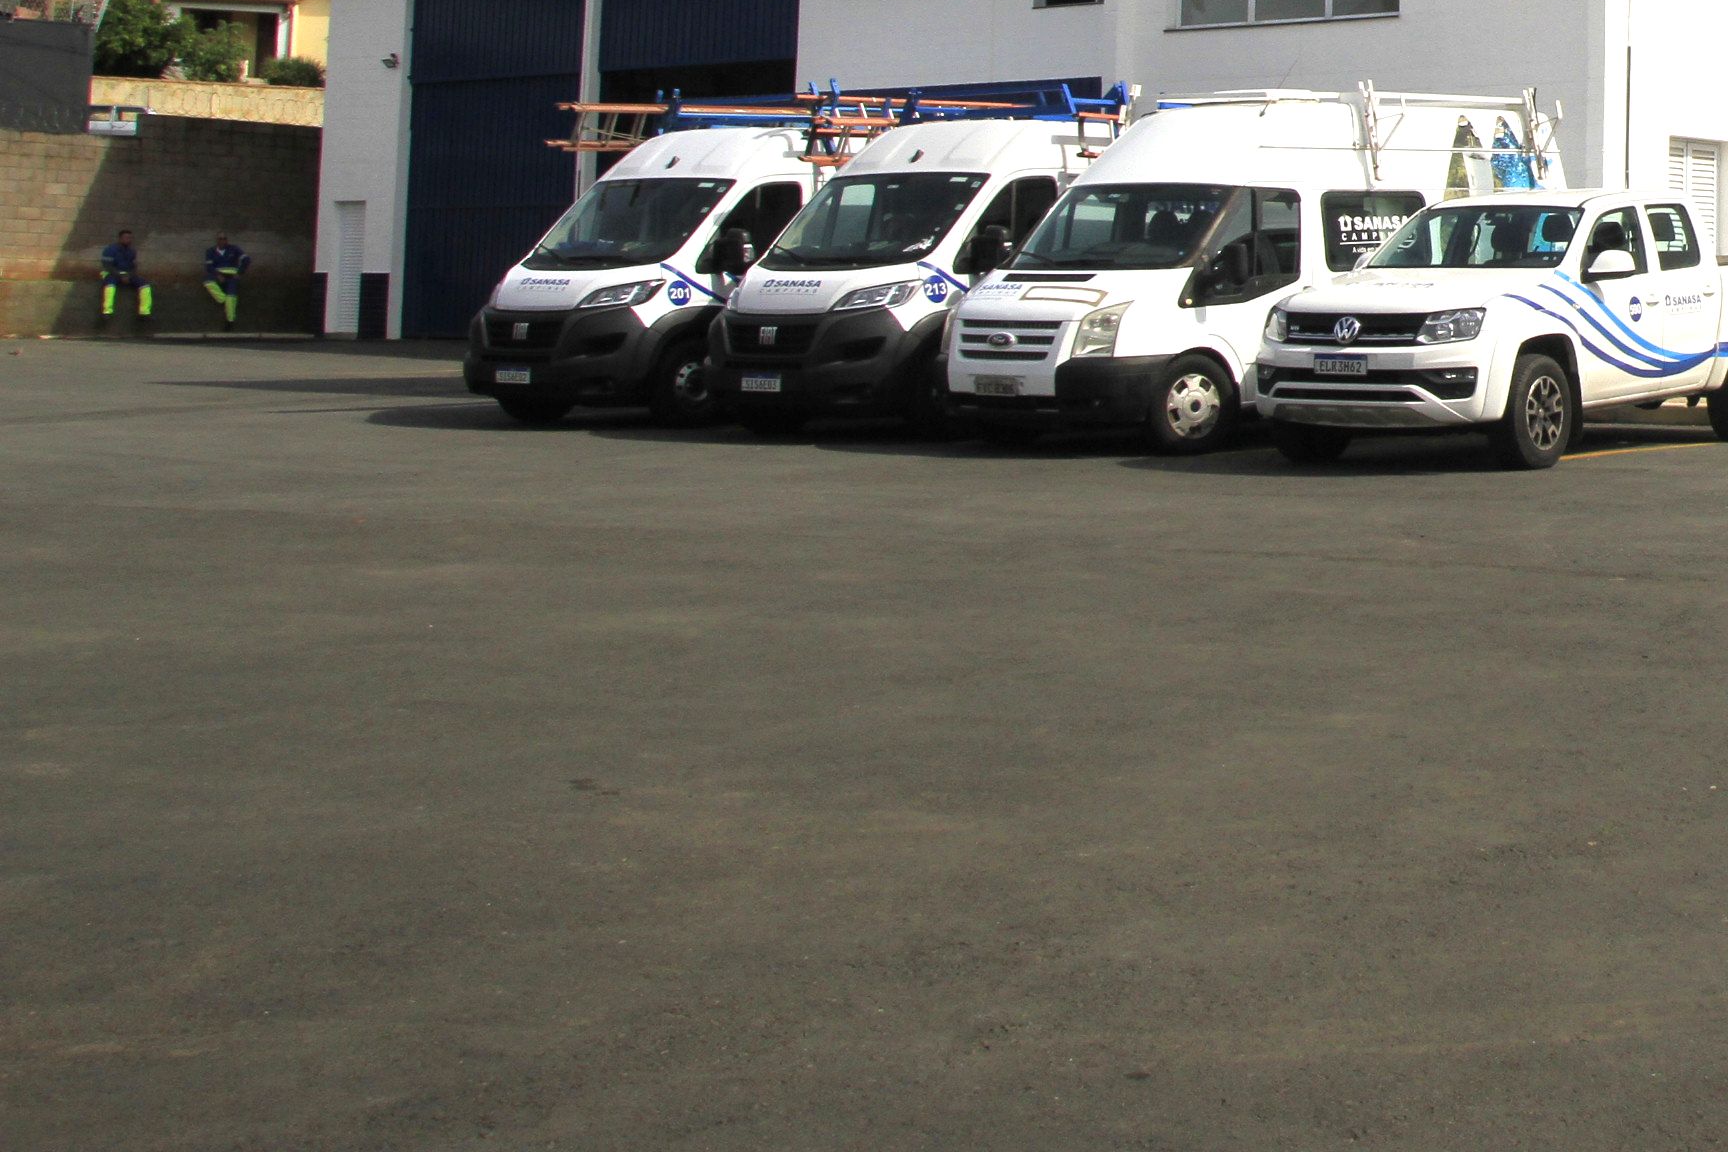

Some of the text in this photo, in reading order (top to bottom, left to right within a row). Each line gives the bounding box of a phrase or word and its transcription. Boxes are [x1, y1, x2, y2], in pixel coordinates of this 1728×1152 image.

[529, 278, 570, 286] SANASA
[774, 279, 822, 288] SANASA
[669, 287, 690, 299] 201
[925, 284, 947, 296] 213
[1672, 294, 1702, 306] SANASA
[759, 326, 778, 345] FIAT
[1319, 360, 1362, 373] ELR3H62
